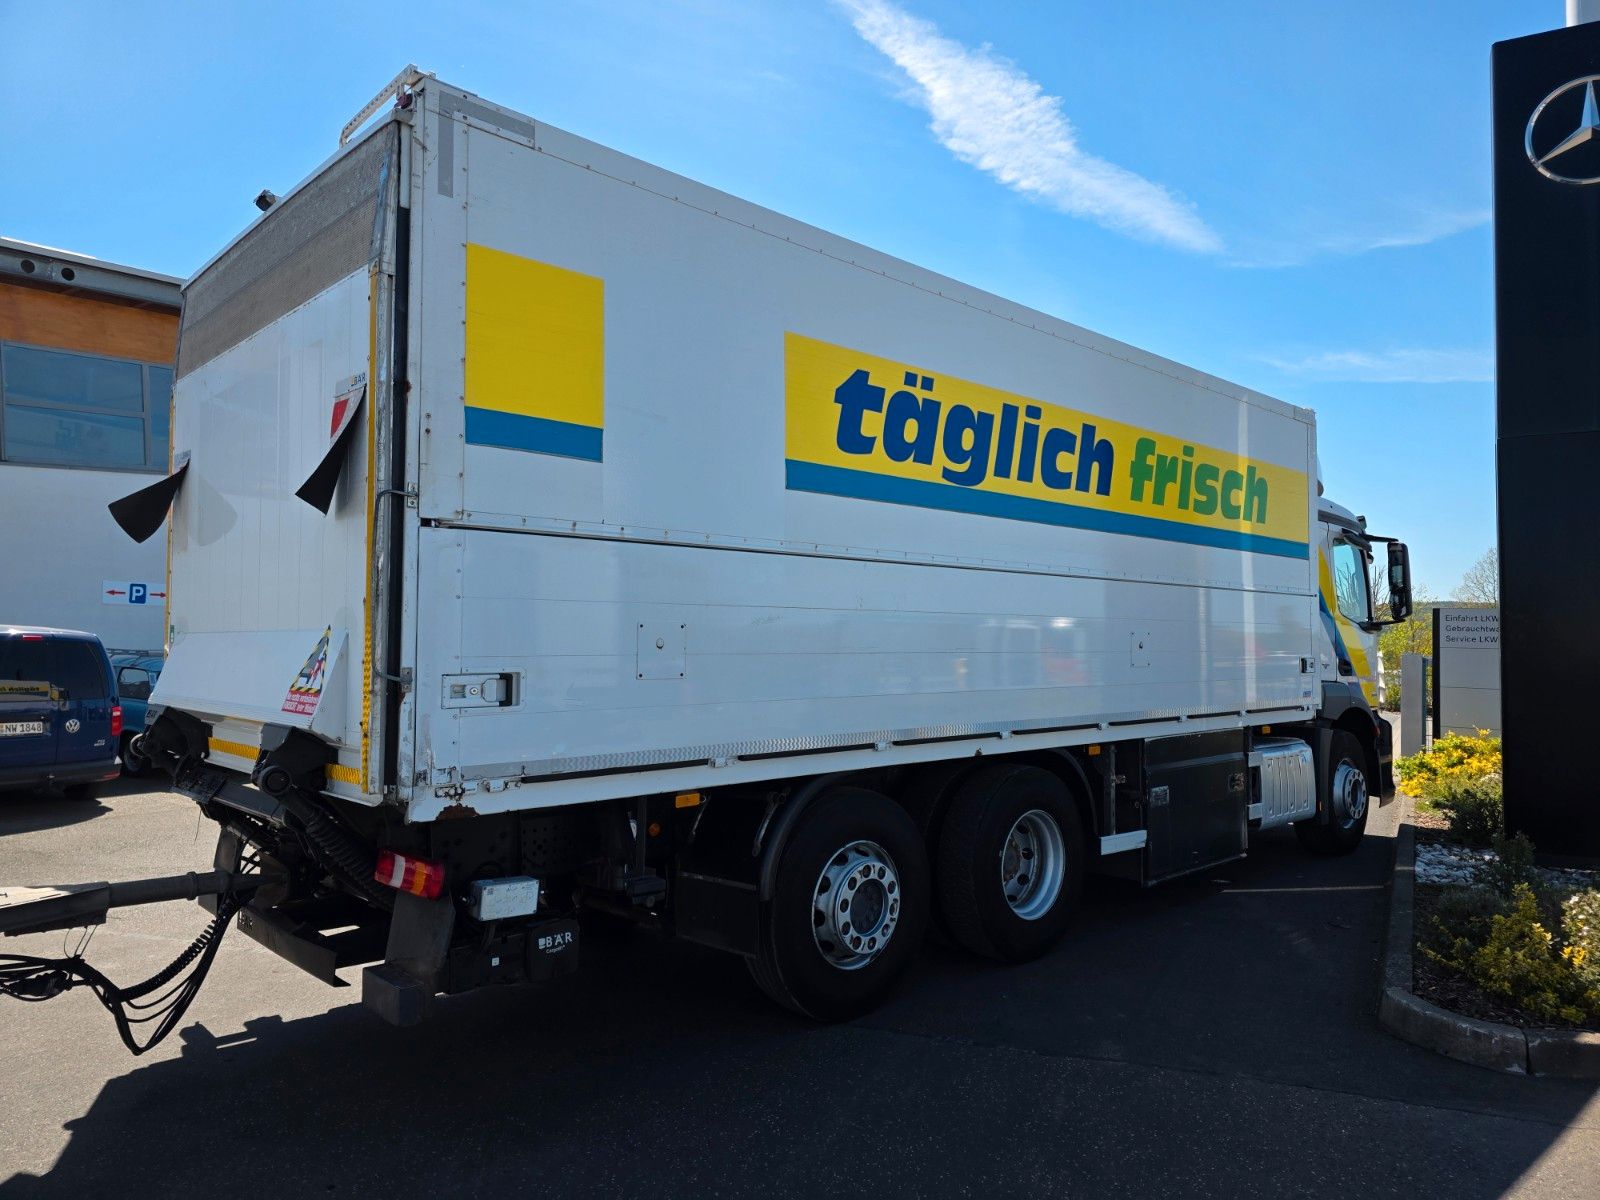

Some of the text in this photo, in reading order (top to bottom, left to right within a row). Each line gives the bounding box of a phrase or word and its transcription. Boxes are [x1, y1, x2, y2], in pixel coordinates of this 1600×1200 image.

[833, 368, 1269, 525] täglich frisch
[132, 586, 144, 601] P
[1445, 614, 1478, 622] Einfahrt
[1445, 635, 1499, 643] Service LKW
[19, 723, 42, 733] 1848
